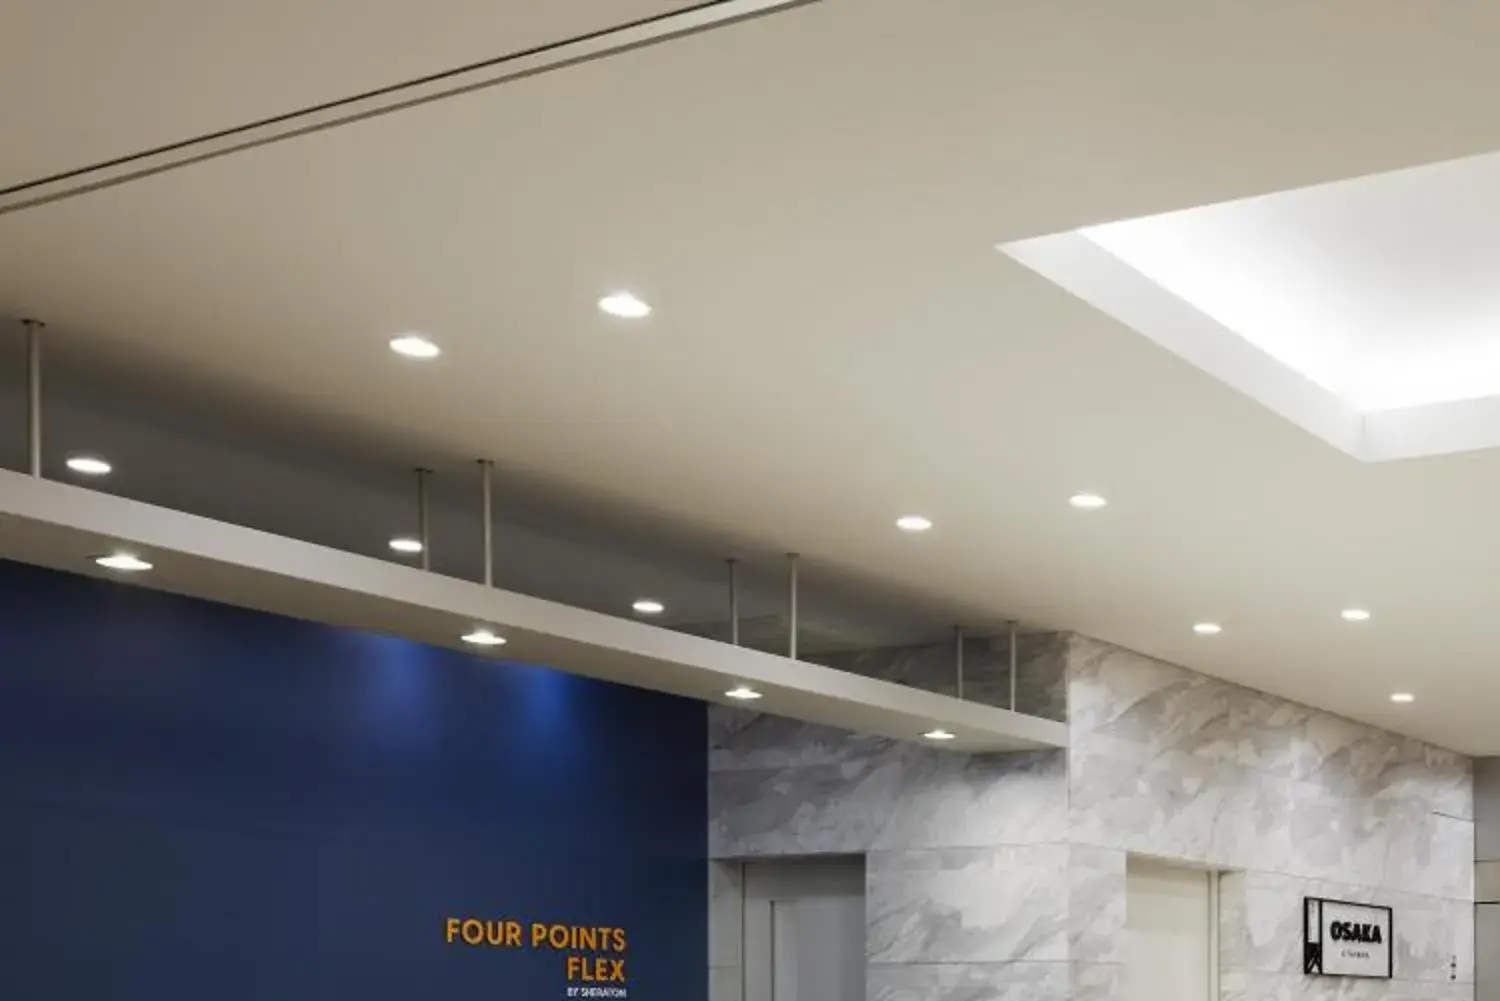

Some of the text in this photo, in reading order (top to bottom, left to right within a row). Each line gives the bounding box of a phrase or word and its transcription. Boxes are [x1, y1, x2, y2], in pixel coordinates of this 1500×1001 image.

[447, 917, 626, 951] FOUR POINTS
[1330, 921, 1382, 944] OSAKA
[567, 956, 625, 982] FLEX
[567, 987, 578, 997] BY
